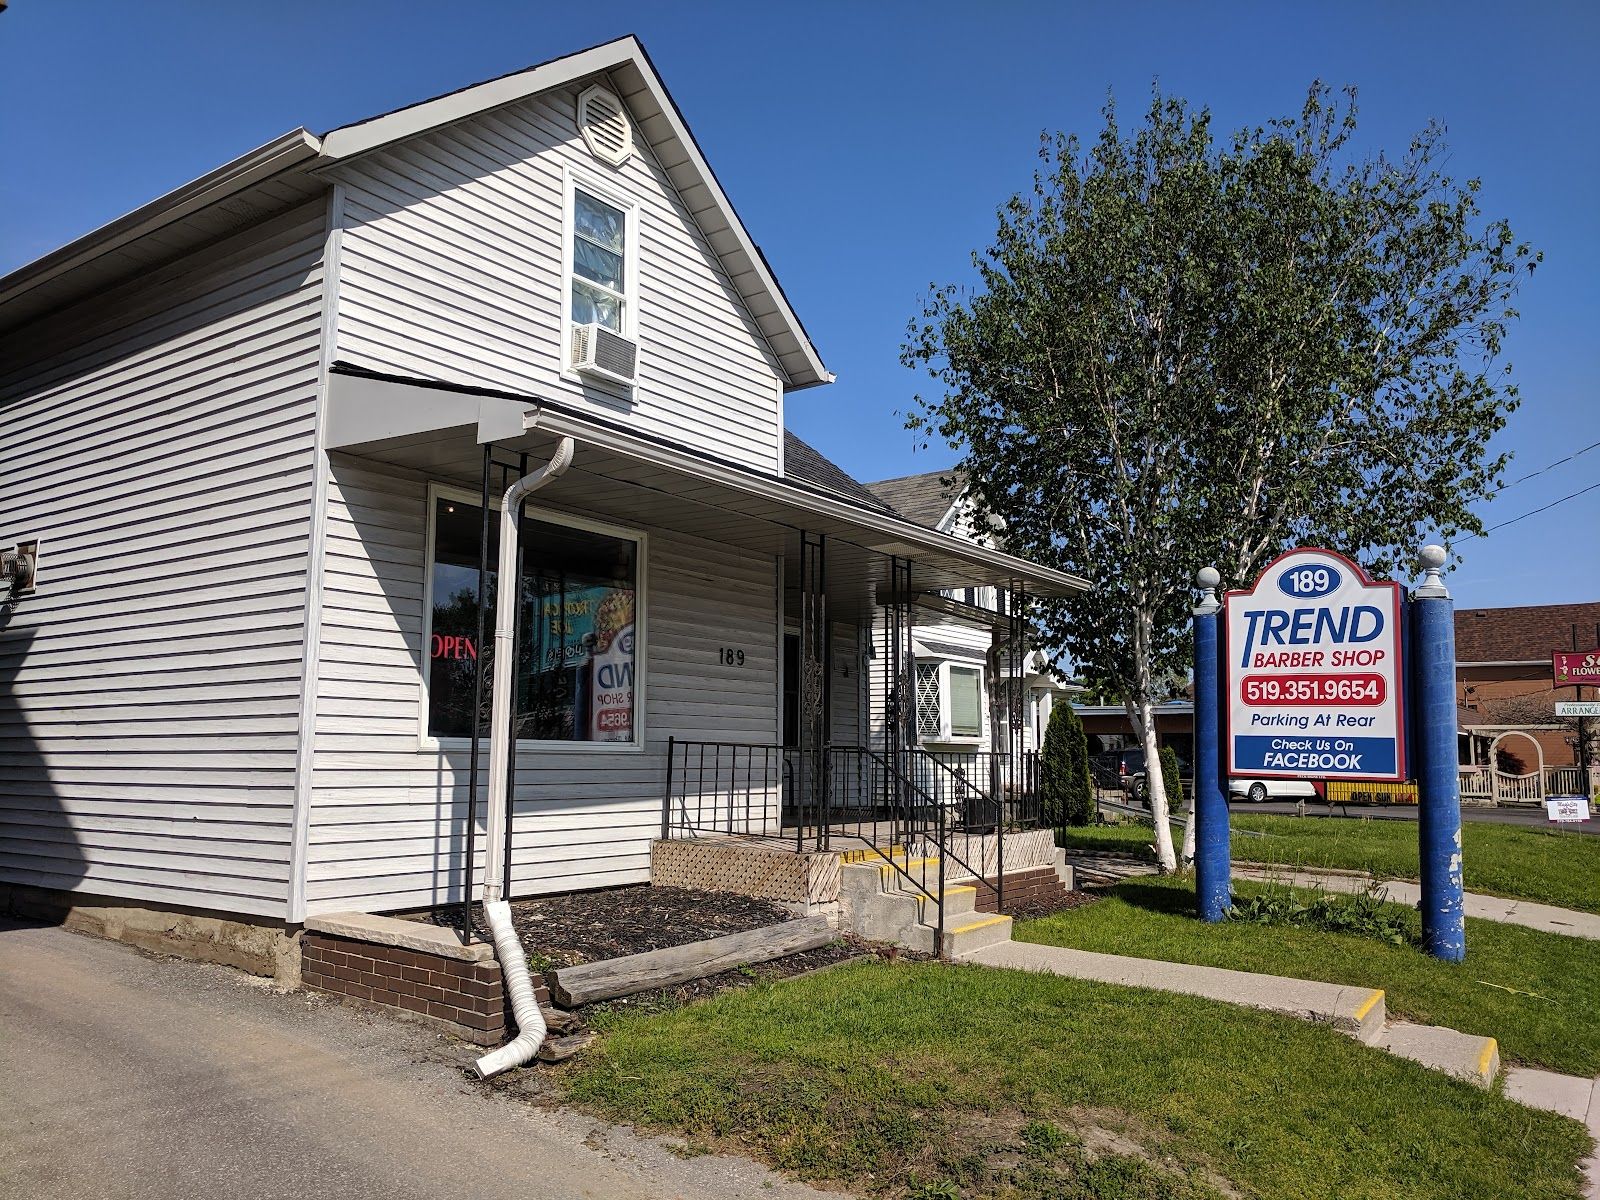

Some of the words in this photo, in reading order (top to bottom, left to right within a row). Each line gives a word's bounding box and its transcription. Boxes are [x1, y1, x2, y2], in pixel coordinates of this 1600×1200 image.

[1290, 570, 1329, 592] 189
[1241, 606, 1384, 668] TREND
[431, 635, 476, 660] OPEN
[719, 647, 744, 666] 189
[1254, 652, 1324, 668] BARBER
[1331, 650, 1385, 666] SHOP
[1247, 680, 1379, 700] 519.351.9654
[1251, 713, 1308, 729] Parking
[1313, 714, 1331, 727] At
[1336, 714, 1375, 727] Rear
[1271, 739, 1312, 751] Check
[1316, 740, 1331, 751] Us
[1335, 740, 1354, 751] On
[1263, 753, 1363, 770] FACEBOOK
